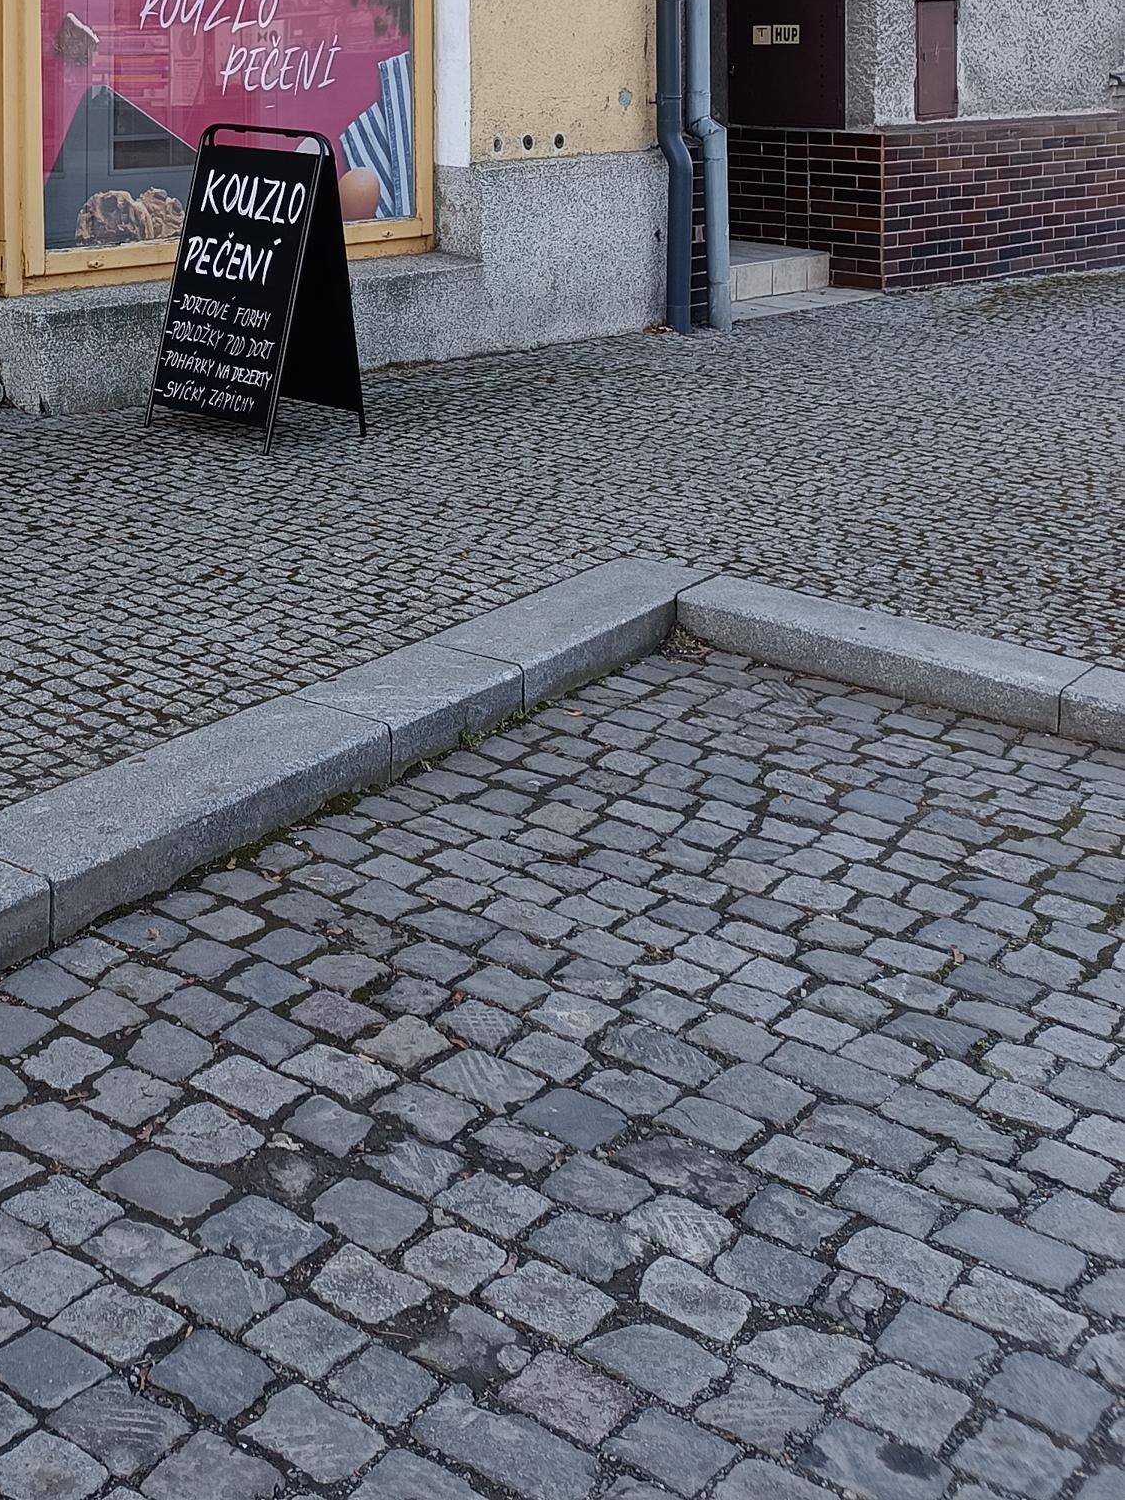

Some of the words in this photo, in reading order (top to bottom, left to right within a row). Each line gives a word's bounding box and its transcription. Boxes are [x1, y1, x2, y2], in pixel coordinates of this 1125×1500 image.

[775, 27, 798, 42] HUP
[220, 34, 343, 96] PEČENÍ
[200, 169, 306, 225] KOUZLO
[183, 231, 283, 286] PEČENÍ
[233, 306, 272, 331] FORMY
[224, 334, 246, 357] POD
[245, 337, 276, 360] DORT
[215, 362, 230, 380] NA
[230, 366, 273, 391] DEZERTY
